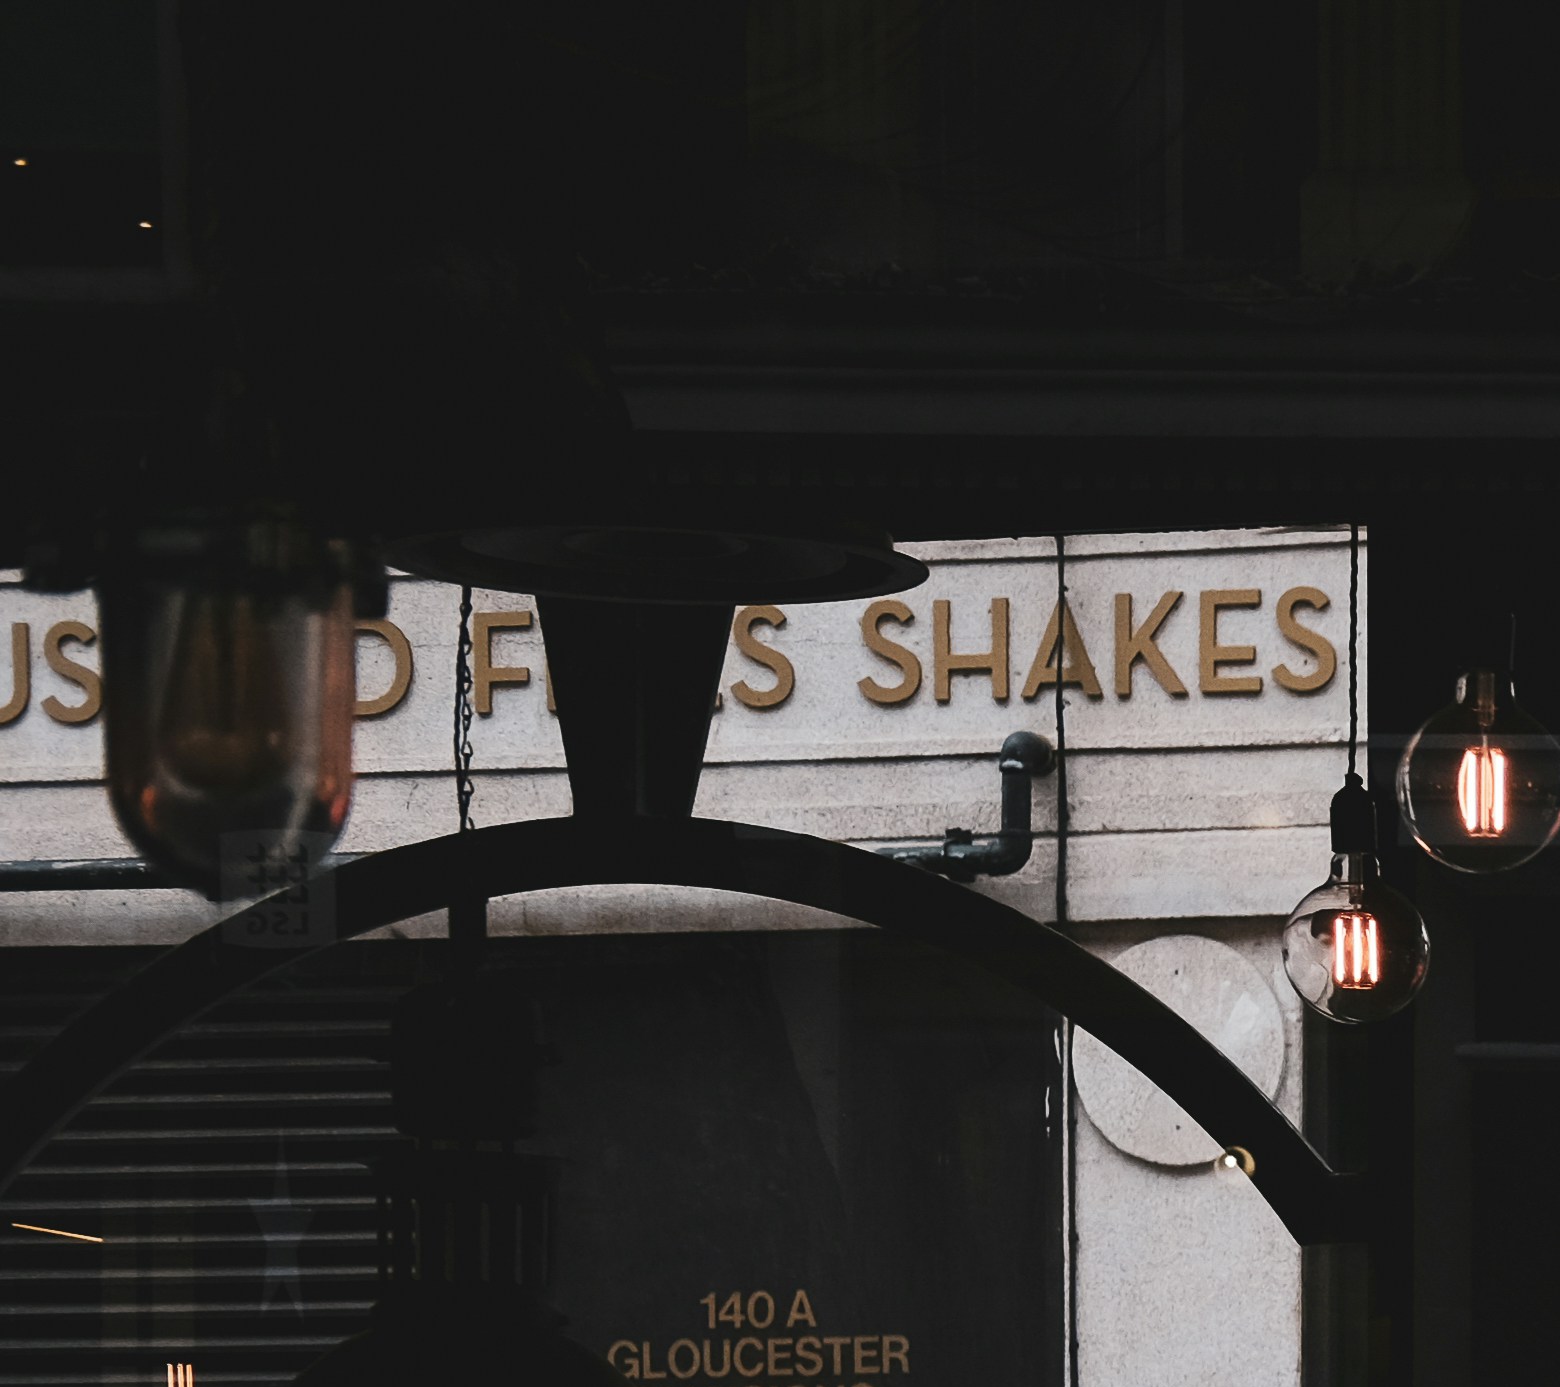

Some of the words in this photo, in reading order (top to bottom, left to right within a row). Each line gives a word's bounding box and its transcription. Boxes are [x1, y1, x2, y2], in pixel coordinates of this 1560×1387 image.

[856, 584, 1340, 707] SHAKES
[699, 1290, 775, 1330] 140
[787, 1288, 818, 1329] A
[607, 1334, 911, 1380] GLOUCESTER
